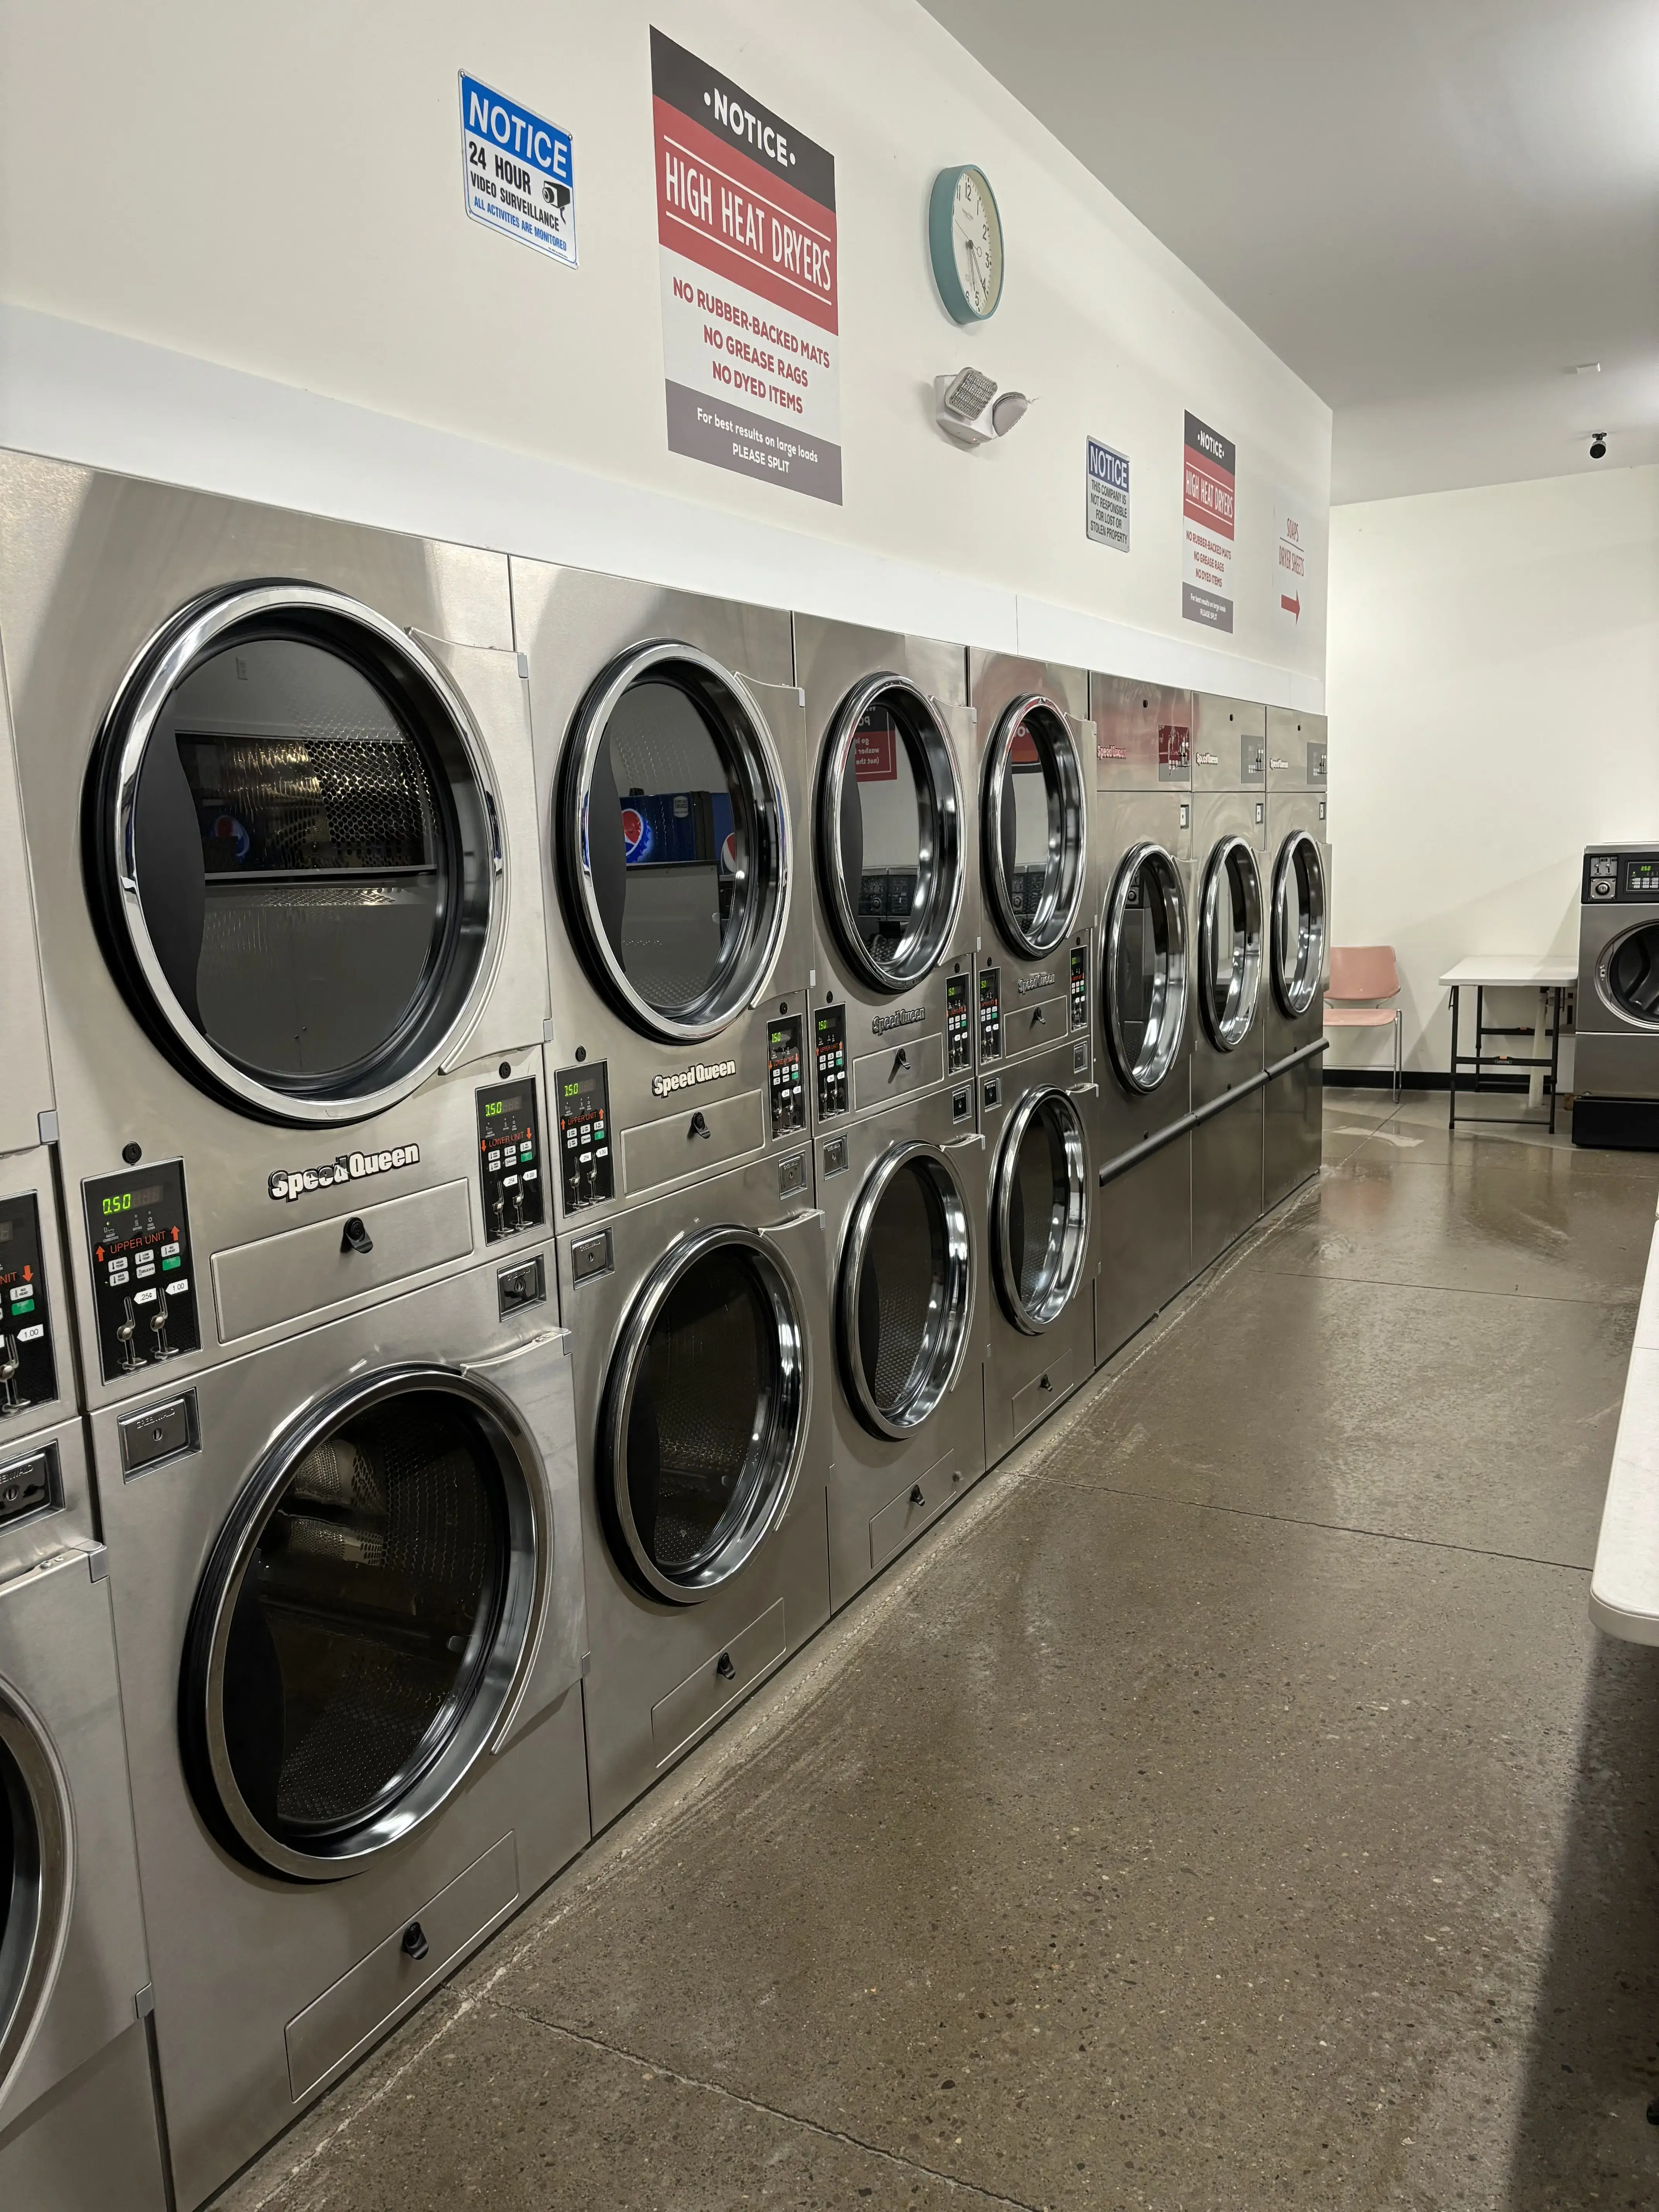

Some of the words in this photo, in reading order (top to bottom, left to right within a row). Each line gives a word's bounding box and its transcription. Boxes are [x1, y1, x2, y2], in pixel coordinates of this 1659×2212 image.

[469, 91, 567, 178] NOTICE
[714, 88, 788, 167] NOTICE
[469, 141, 486, 170] 24
[495, 154, 531, 195] HOUR
[470, 170, 496, 198] VIDEO
[500, 187, 559, 232] SURVEILLANCE
[965, 182, 971, 202] 12
[474, 196, 485, 211] ALL
[487, 203, 519, 228] ACTIVITIES
[522, 220, 533, 234] ARE
[534, 227, 566, 251] MONITORED
[666, 152, 713, 225] HIGH
[721, 187, 764, 254] HEAT
[772, 218, 831, 291] DRYERS
[983, 224, 987, 240] 2
[986, 252, 989, 268] 3
[975, 291, 979, 306] 5
[673, 276, 694, 303] NO
[697, 288, 798, 354] RUBBER-BACKED
[801, 340, 830, 369] MATS
[704, 324, 723, 349] NO
[726, 336, 774, 373] GREASE
[778, 358, 808, 387] RAGS
[712, 361, 731, 384] NO
[734, 369, 766, 398] DYED
[769, 385, 803, 414] ITEMS
[697, 407, 712, 425] For
[714, 414, 733, 433] best
[735, 424, 763, 443] results
[765, 435, 775, 448] on
[777, 436, 797, 457] large
[798, 444, 818, 463] loads
[1200, 430, 1222, 459] NOTICE
[733, 443, 766, 466] PLEASE
[768, 456, 790, 473] SPLIT
[1091, 445, 1127, 488] NOTICE
[1092, 479, 1100, 493] THIS
[1101, 484, 1121, 503] COMPANY
[1122, 494, 1126, 505] IS
[1186, 469, 1199, 500] HIGH
[1201, 478, 1214, 507] HEAT
[1215, 487, 1233, 519] DRYERS
[1091, 493, 1099, 506] NOT
[1100, 497, 1127, 519] RESPONSIBLE
[1091, 520, 1106, 536] STOLEN
[1107, 527, 1128, 544] PROPERTY
[1104, 513, 1115, 527] LOST
[1116, 518, 1122, 529] OR
[1186, 530, 1192, 541] NO
[1222, 547, 1231, 560] MATS
[1194, 550, 1199, 562] NO
[1200, 553, 1214, 568] GREASE
[1214, 560, 1224, 572] RAGS
[1196, 568, 1201, 579] NO
[1202, 570, 1211, 582] DYED
[1212, 575, 1222, 587] ITEMS
[568, 1115, 585, 1125] UPPER
[586, 1111, 597, 1120] UNIT
[489, 1136, 510, 1147] LOWER
[511, 1132, 524, 1141] UNIT
[110, 1237, 142, 1254] UPPER
[145, 1231, 166, 1244] UNIT
[0, 1271, 17, 1285] NIT
[173, 1283, 184, 1291] 1.00
[24, 1329, 39, 1338] 1.00
